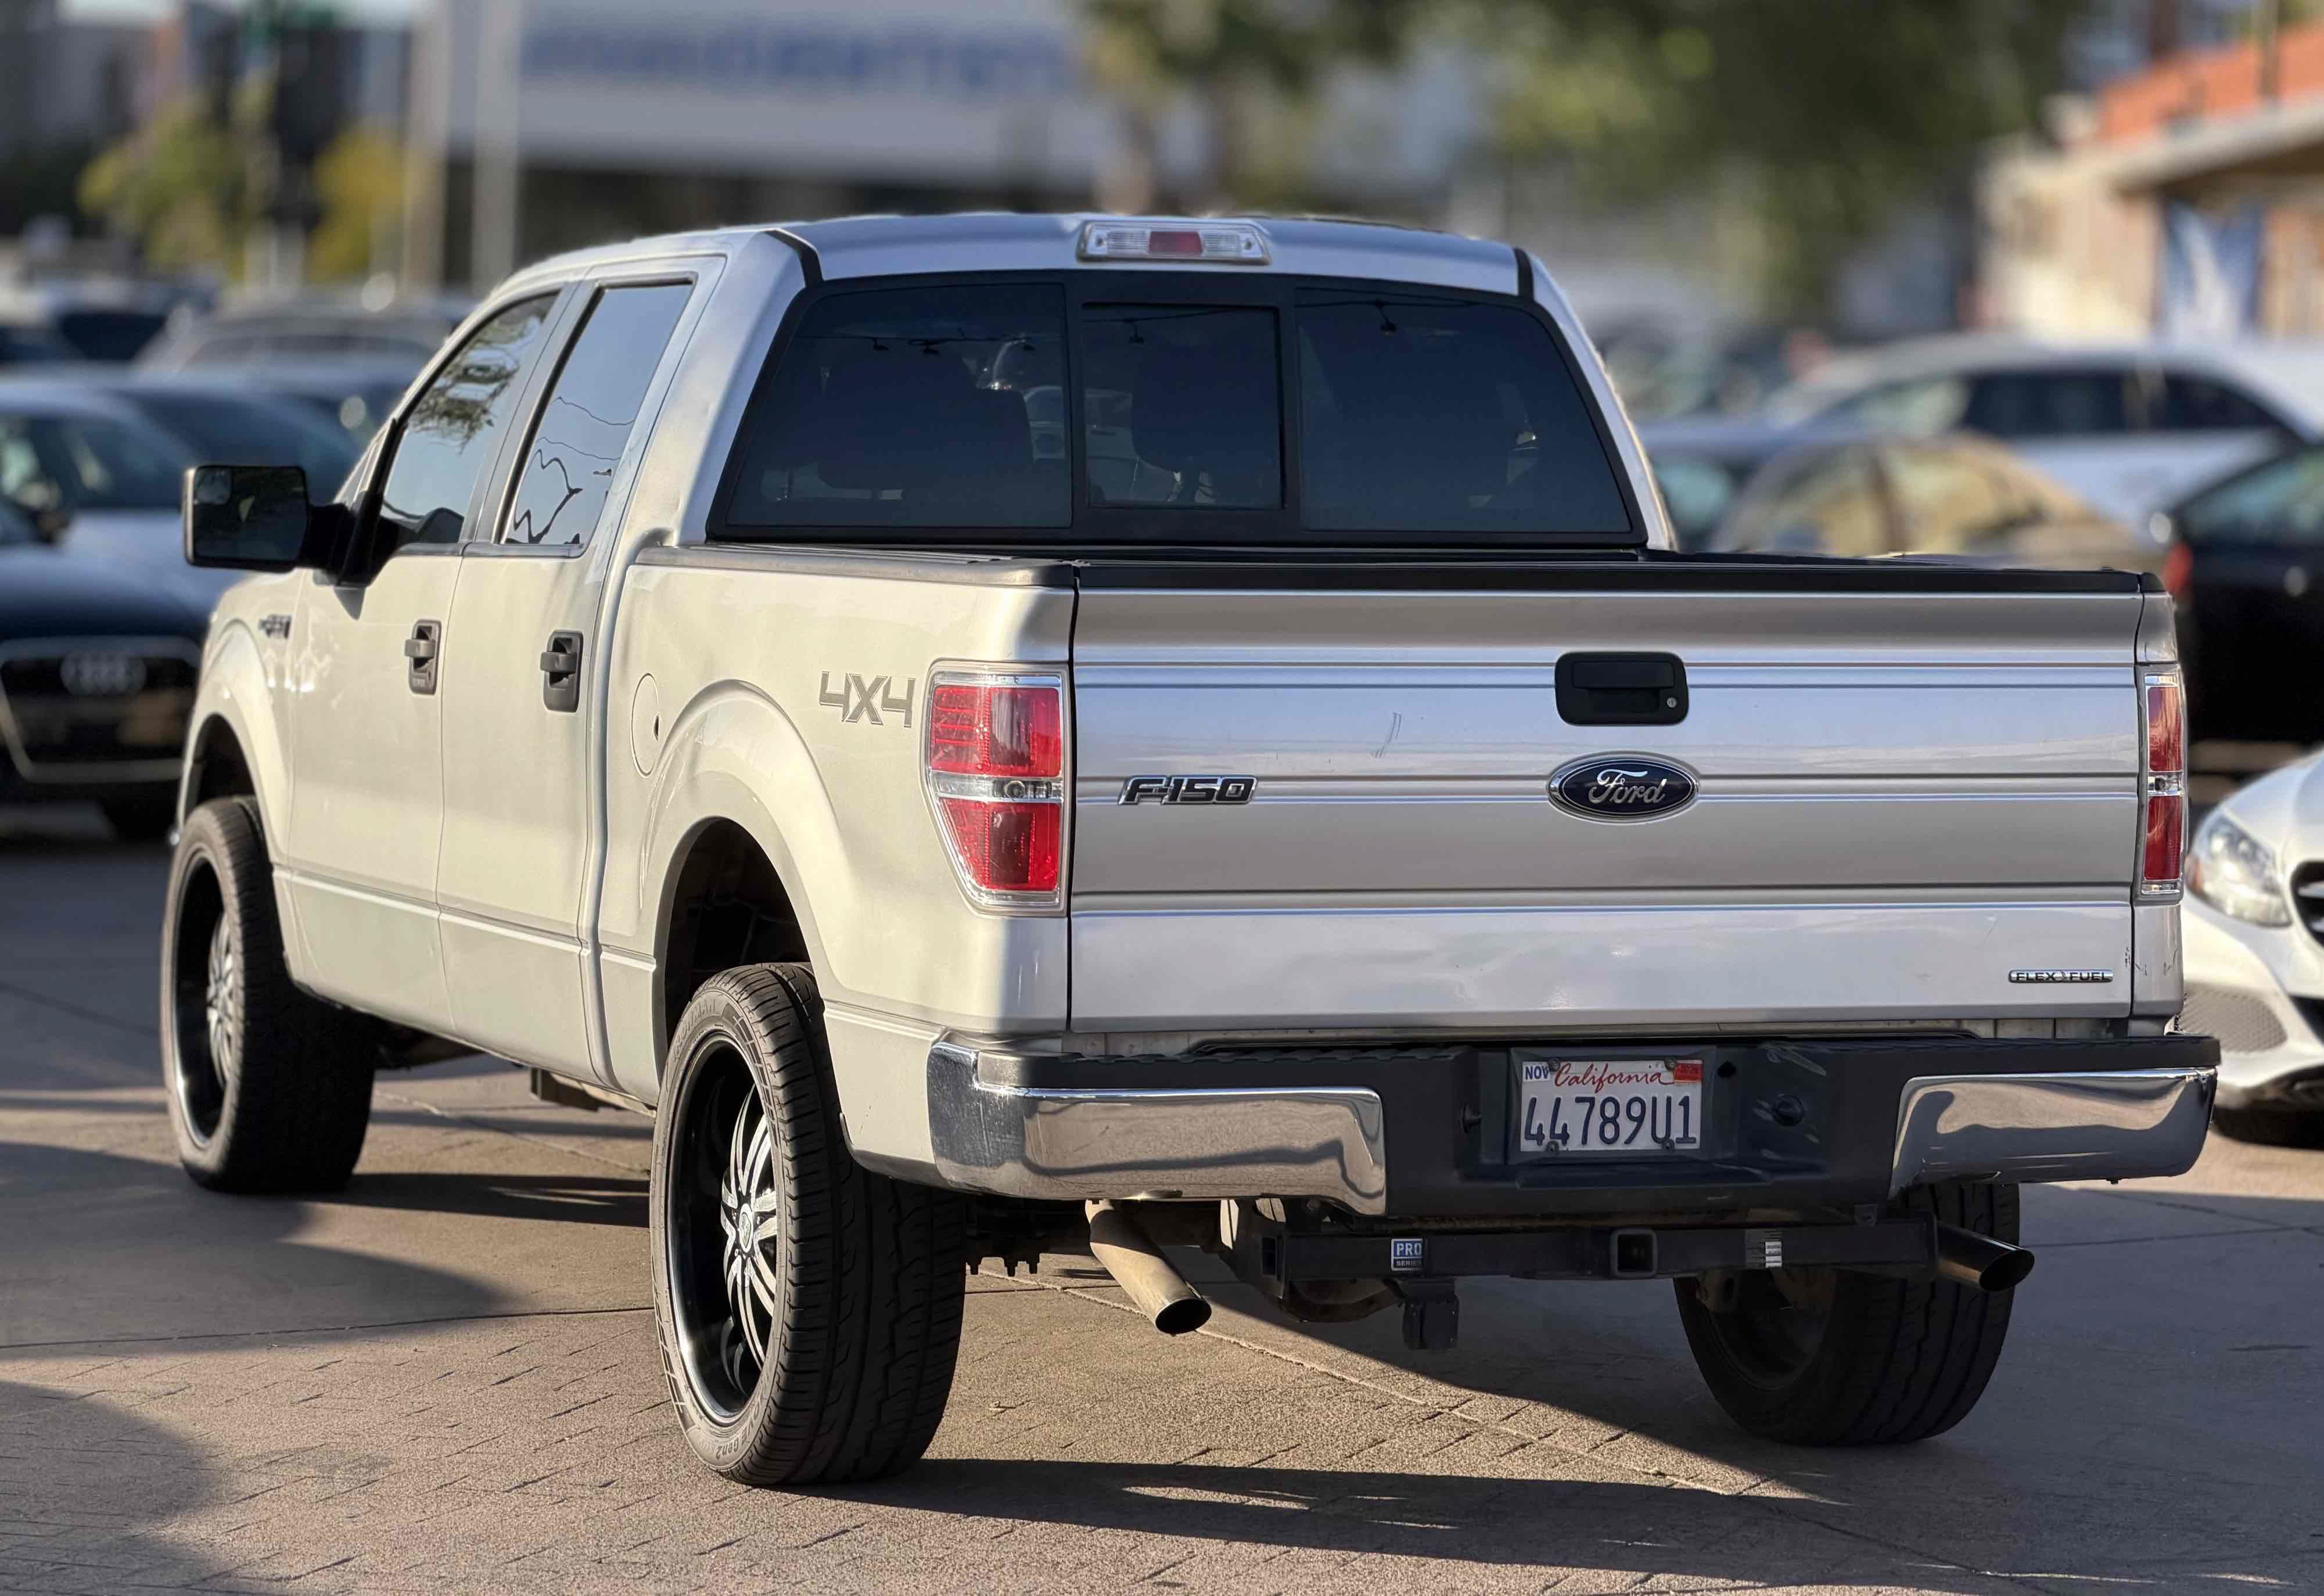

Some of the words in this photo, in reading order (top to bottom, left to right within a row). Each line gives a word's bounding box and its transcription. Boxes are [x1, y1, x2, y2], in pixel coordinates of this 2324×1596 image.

[1588, 769, 1668, 804] Ford
[2016, 972, 2057, 982] FLEX
[2069, 972, 2111, 982] FUEL
[1525, 1065, 1549, 1080] NOV
[1554, 1062, 1675, 1094] California
[1524, 1095, 1697, 1146] 44789U1
[1396, 1243, 1422, 1256] PRO
